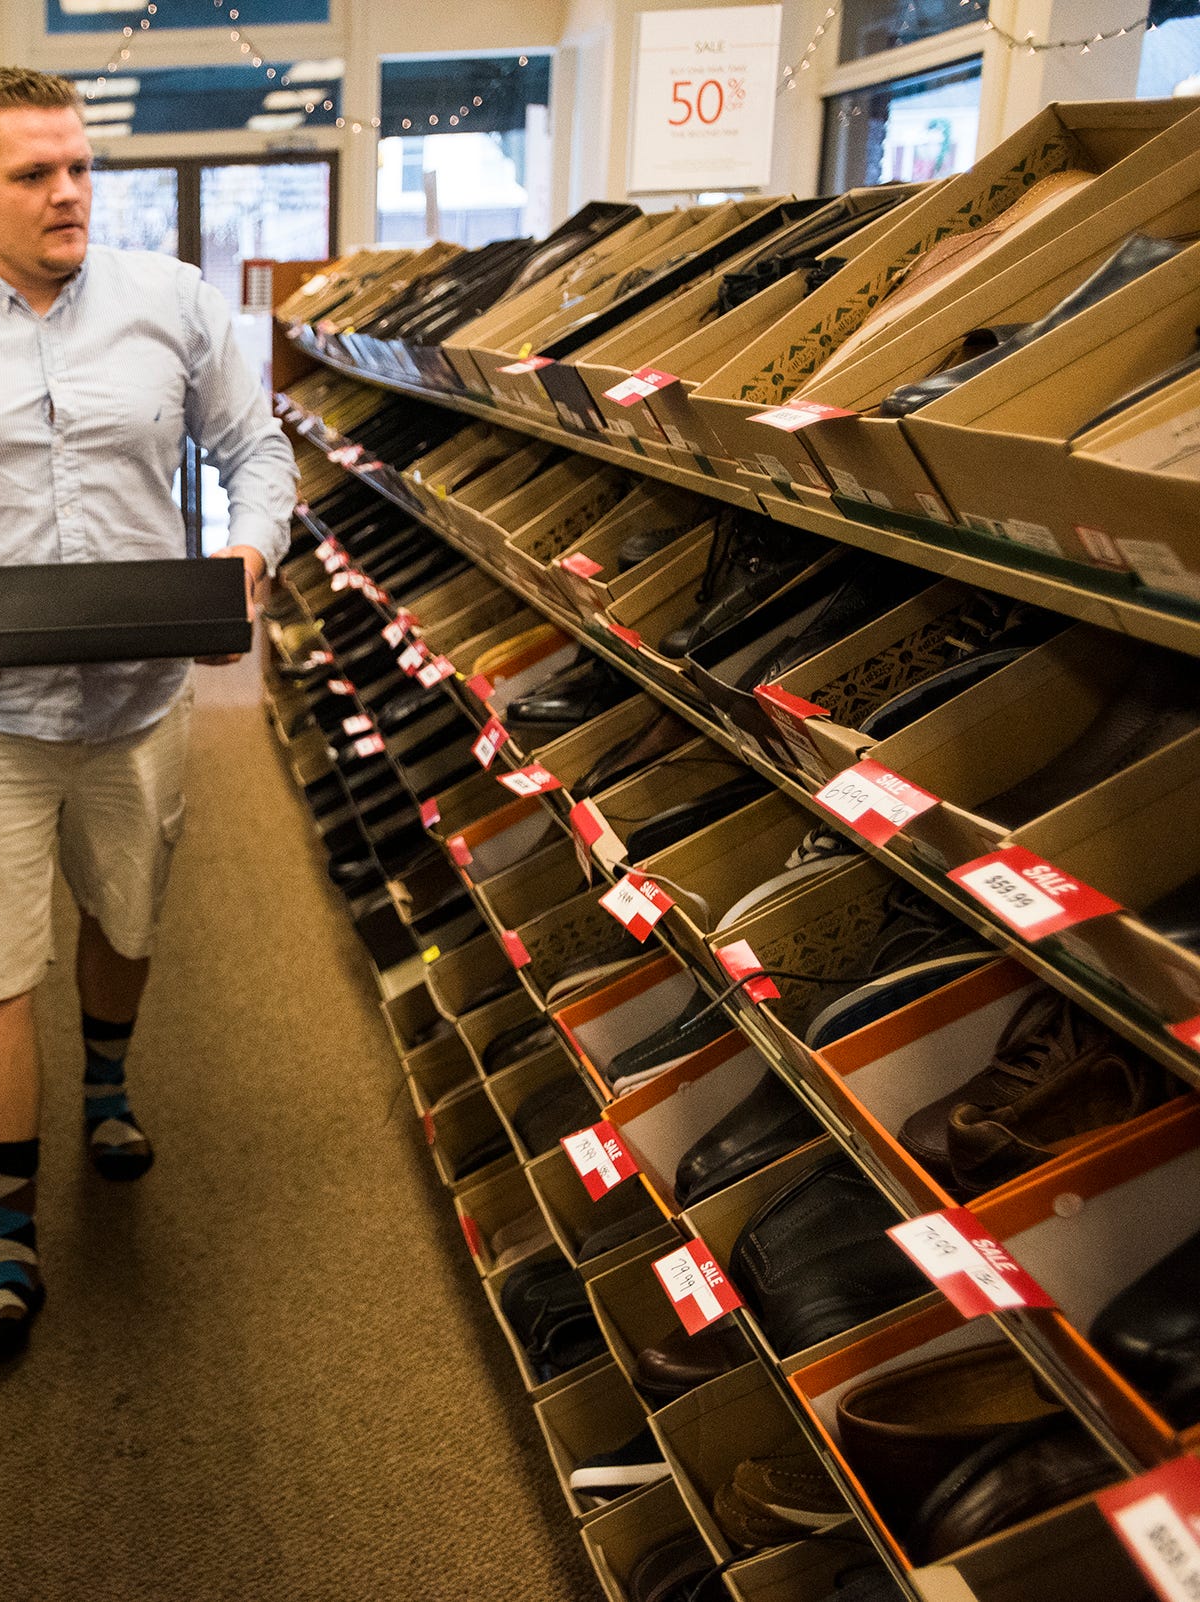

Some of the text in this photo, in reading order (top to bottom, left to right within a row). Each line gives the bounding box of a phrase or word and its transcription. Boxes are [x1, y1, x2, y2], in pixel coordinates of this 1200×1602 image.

[694, 40, 726, 54] SALE
[668, 78, 746, 127] 50%
[876, 773, 913, 796] SALE
[639, 880, 660, 901] SALE
[985, 875, 1035, 909] $59.99
[1021, 865, 1079, 896] SALE
[603, 1138, 623, 1162] SALE
[971, 1237, 1020, 1273] SALE
[699, 1260, 725, 1288] SALE
